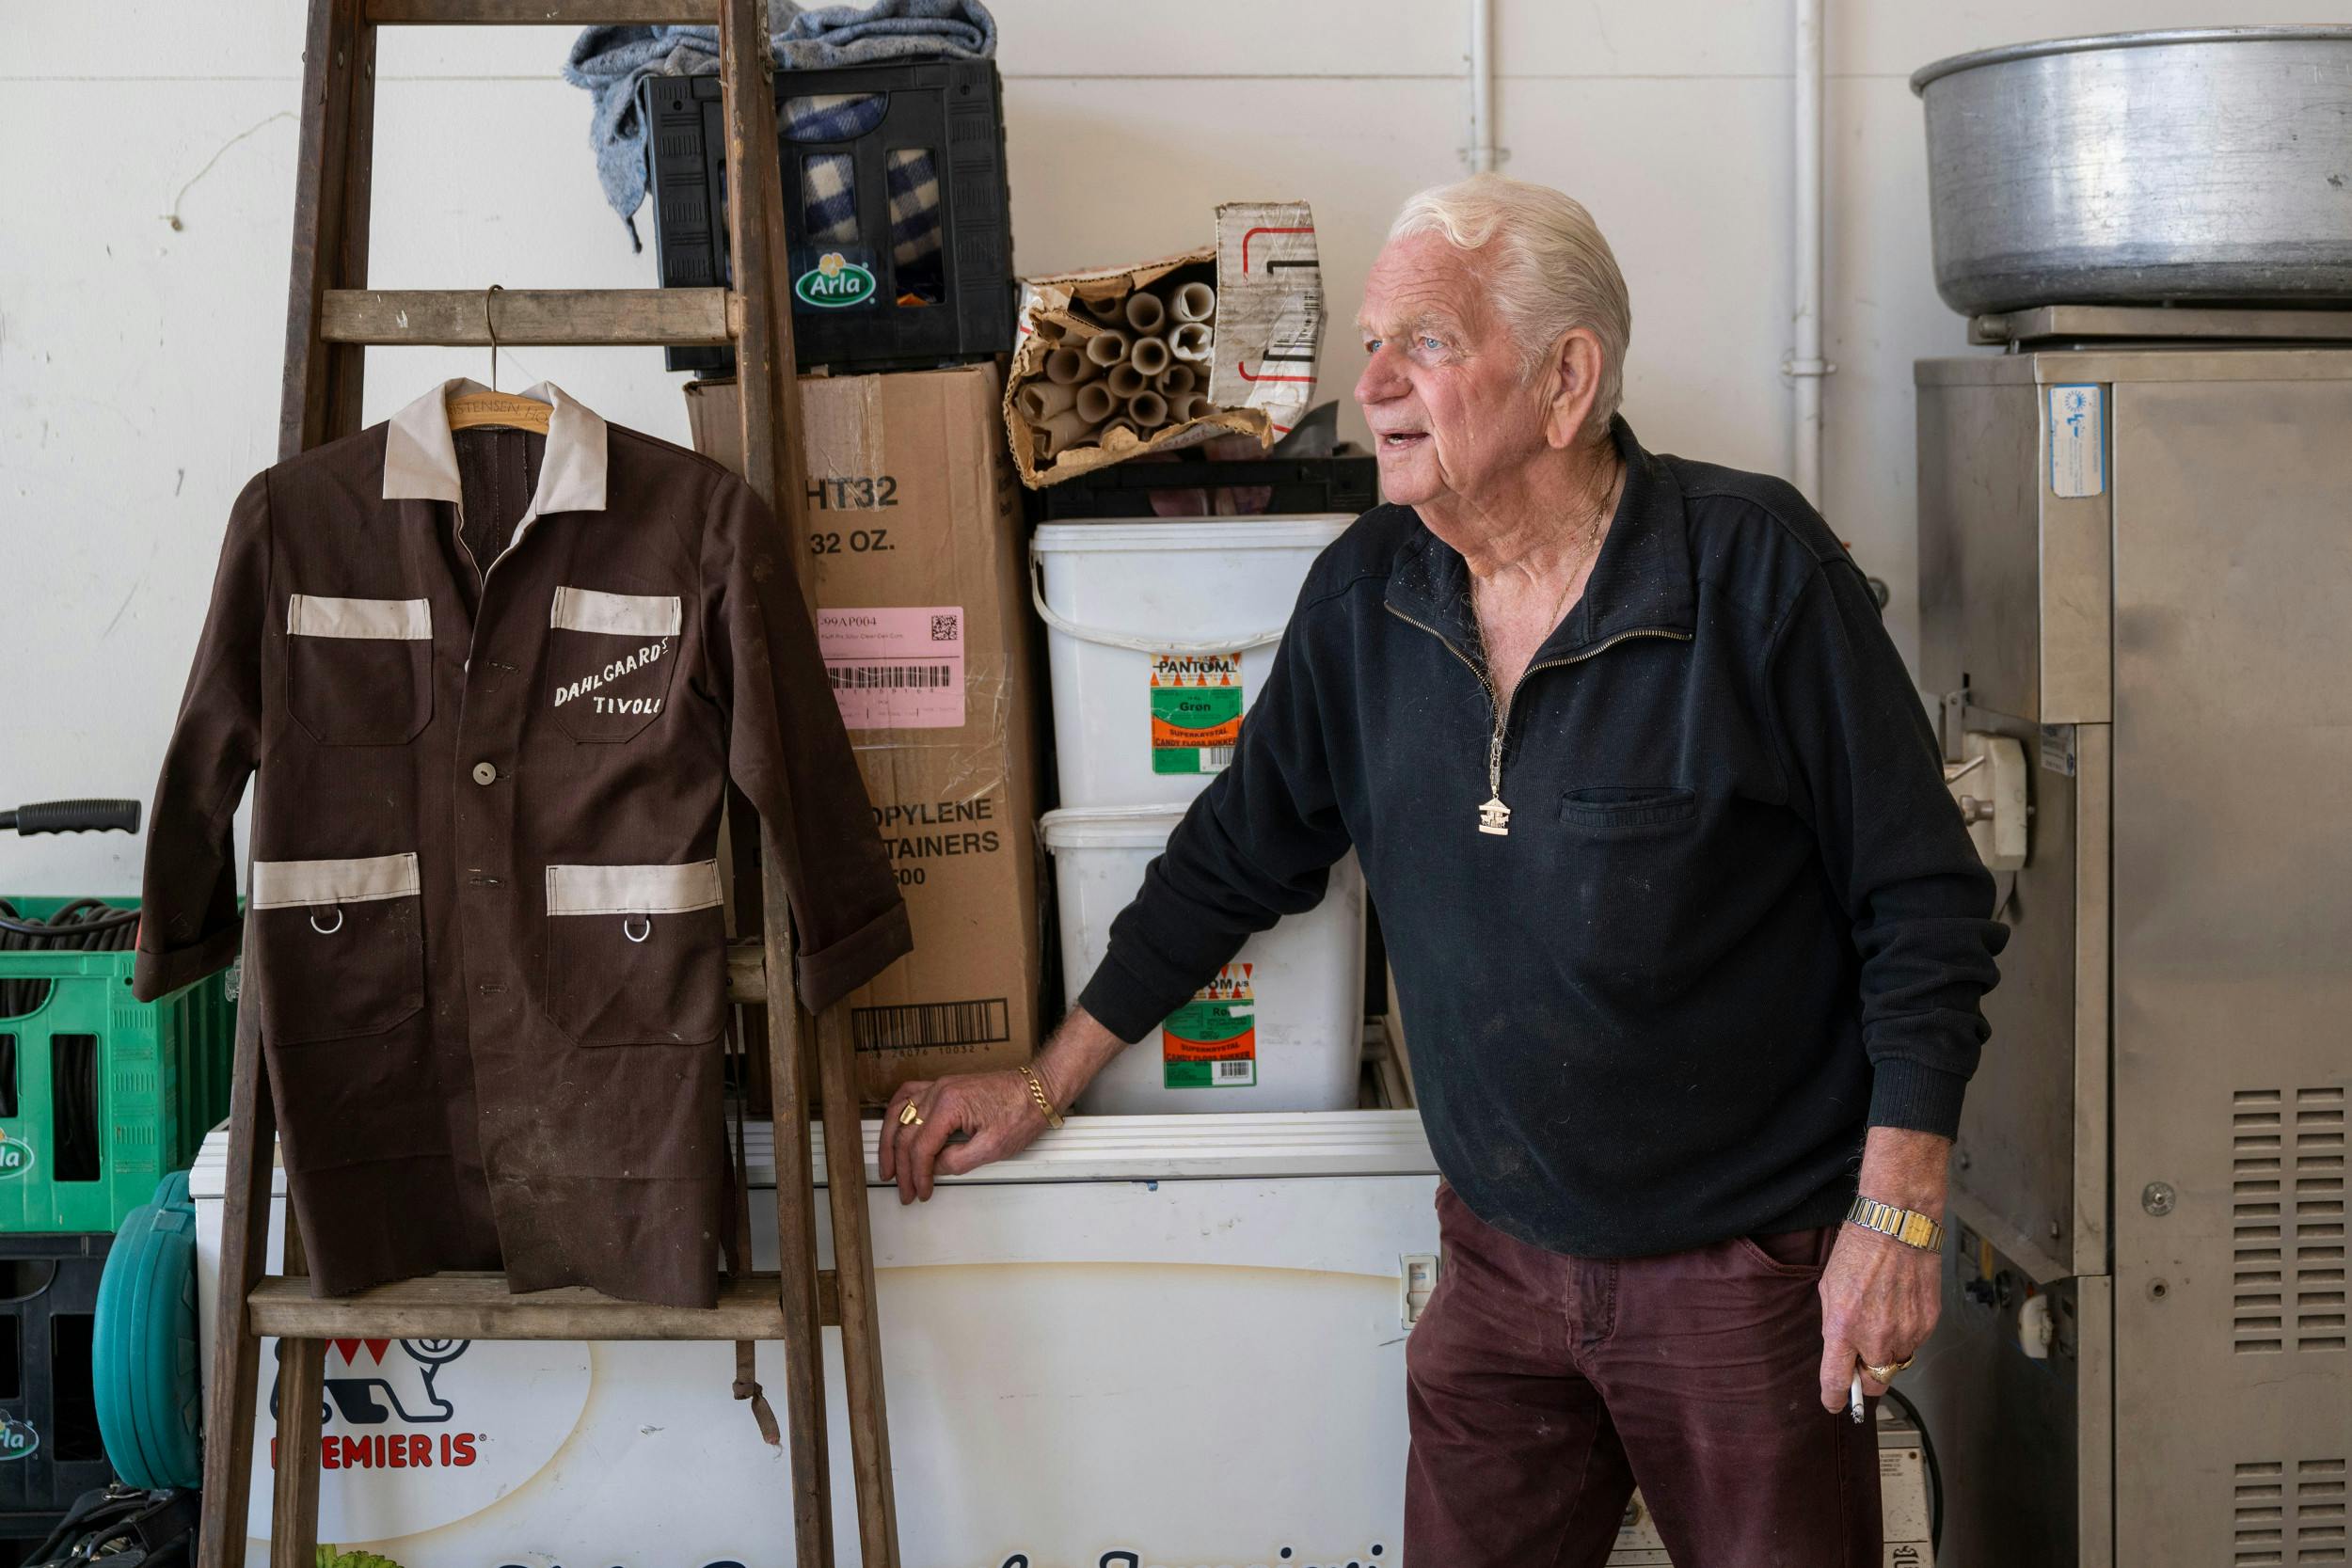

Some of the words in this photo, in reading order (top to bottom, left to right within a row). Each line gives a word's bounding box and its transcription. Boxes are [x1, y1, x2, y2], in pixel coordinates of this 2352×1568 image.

[810, 272, 860, 295] Arla
[805, 476, 898, 510] HT32
[810, 532, 841, 554] 32
[850, 530, 895, 552] OZ.
[594, 696, 661, 714] TIVOLI
[1155, 738, 1180, 747] CANDY
[271, 1433, 433, 1470] EMIER
[440, 1433, 476, 1466] IS
